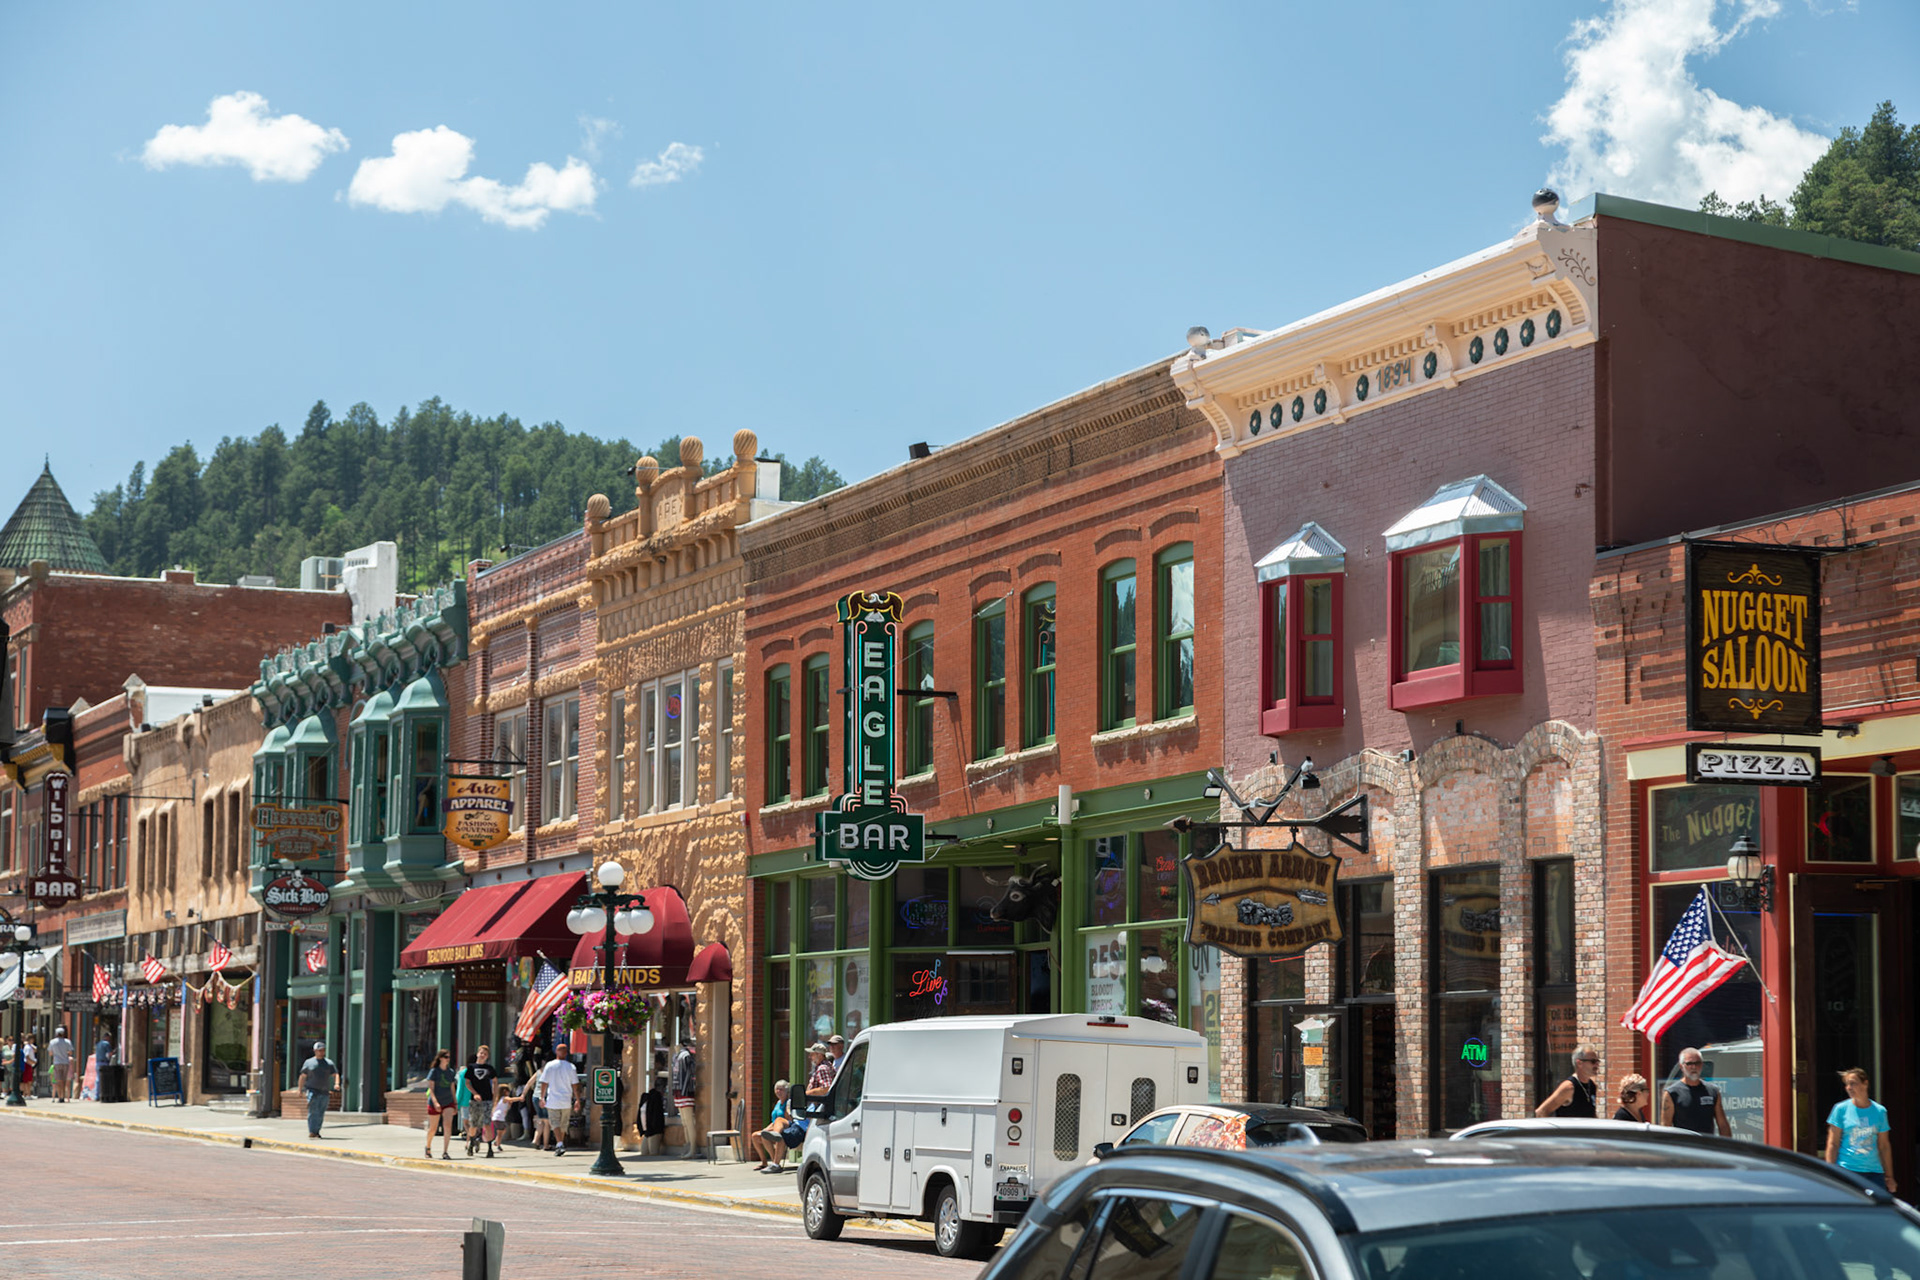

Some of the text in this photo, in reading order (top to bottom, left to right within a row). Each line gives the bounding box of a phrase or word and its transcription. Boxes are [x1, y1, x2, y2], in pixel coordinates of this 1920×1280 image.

[1375, 357, 1411, 391] 1894
[1702, 589, 1808, 649] NUGGET
[1702, 635, 1808, 693] SALOON
[863, 641, 886, 806] EAGLE
[1700, 753, 1811, 776] PIZZA
[51, 779, 64, 823] WILD
[457, 782, 501, 795] Ava
[255, 807, 339, 831] HISTORIC
[450, 798, 509, 812] APPAREL
[1661, 799, 1755, 846] The Nugget
[840, 823, 911, 851] BAR
[1194, 854, 1331, 889] BROKEN ARROW
[35, 882, 76, 897] BAR
[265, 887, 329, 907] Sick Boy
[1202, 919, 1332, 947] TRADING COMPANY
[909, 969, 943, 998] Live
[1461, 1044, 1487, 1061] ATM
